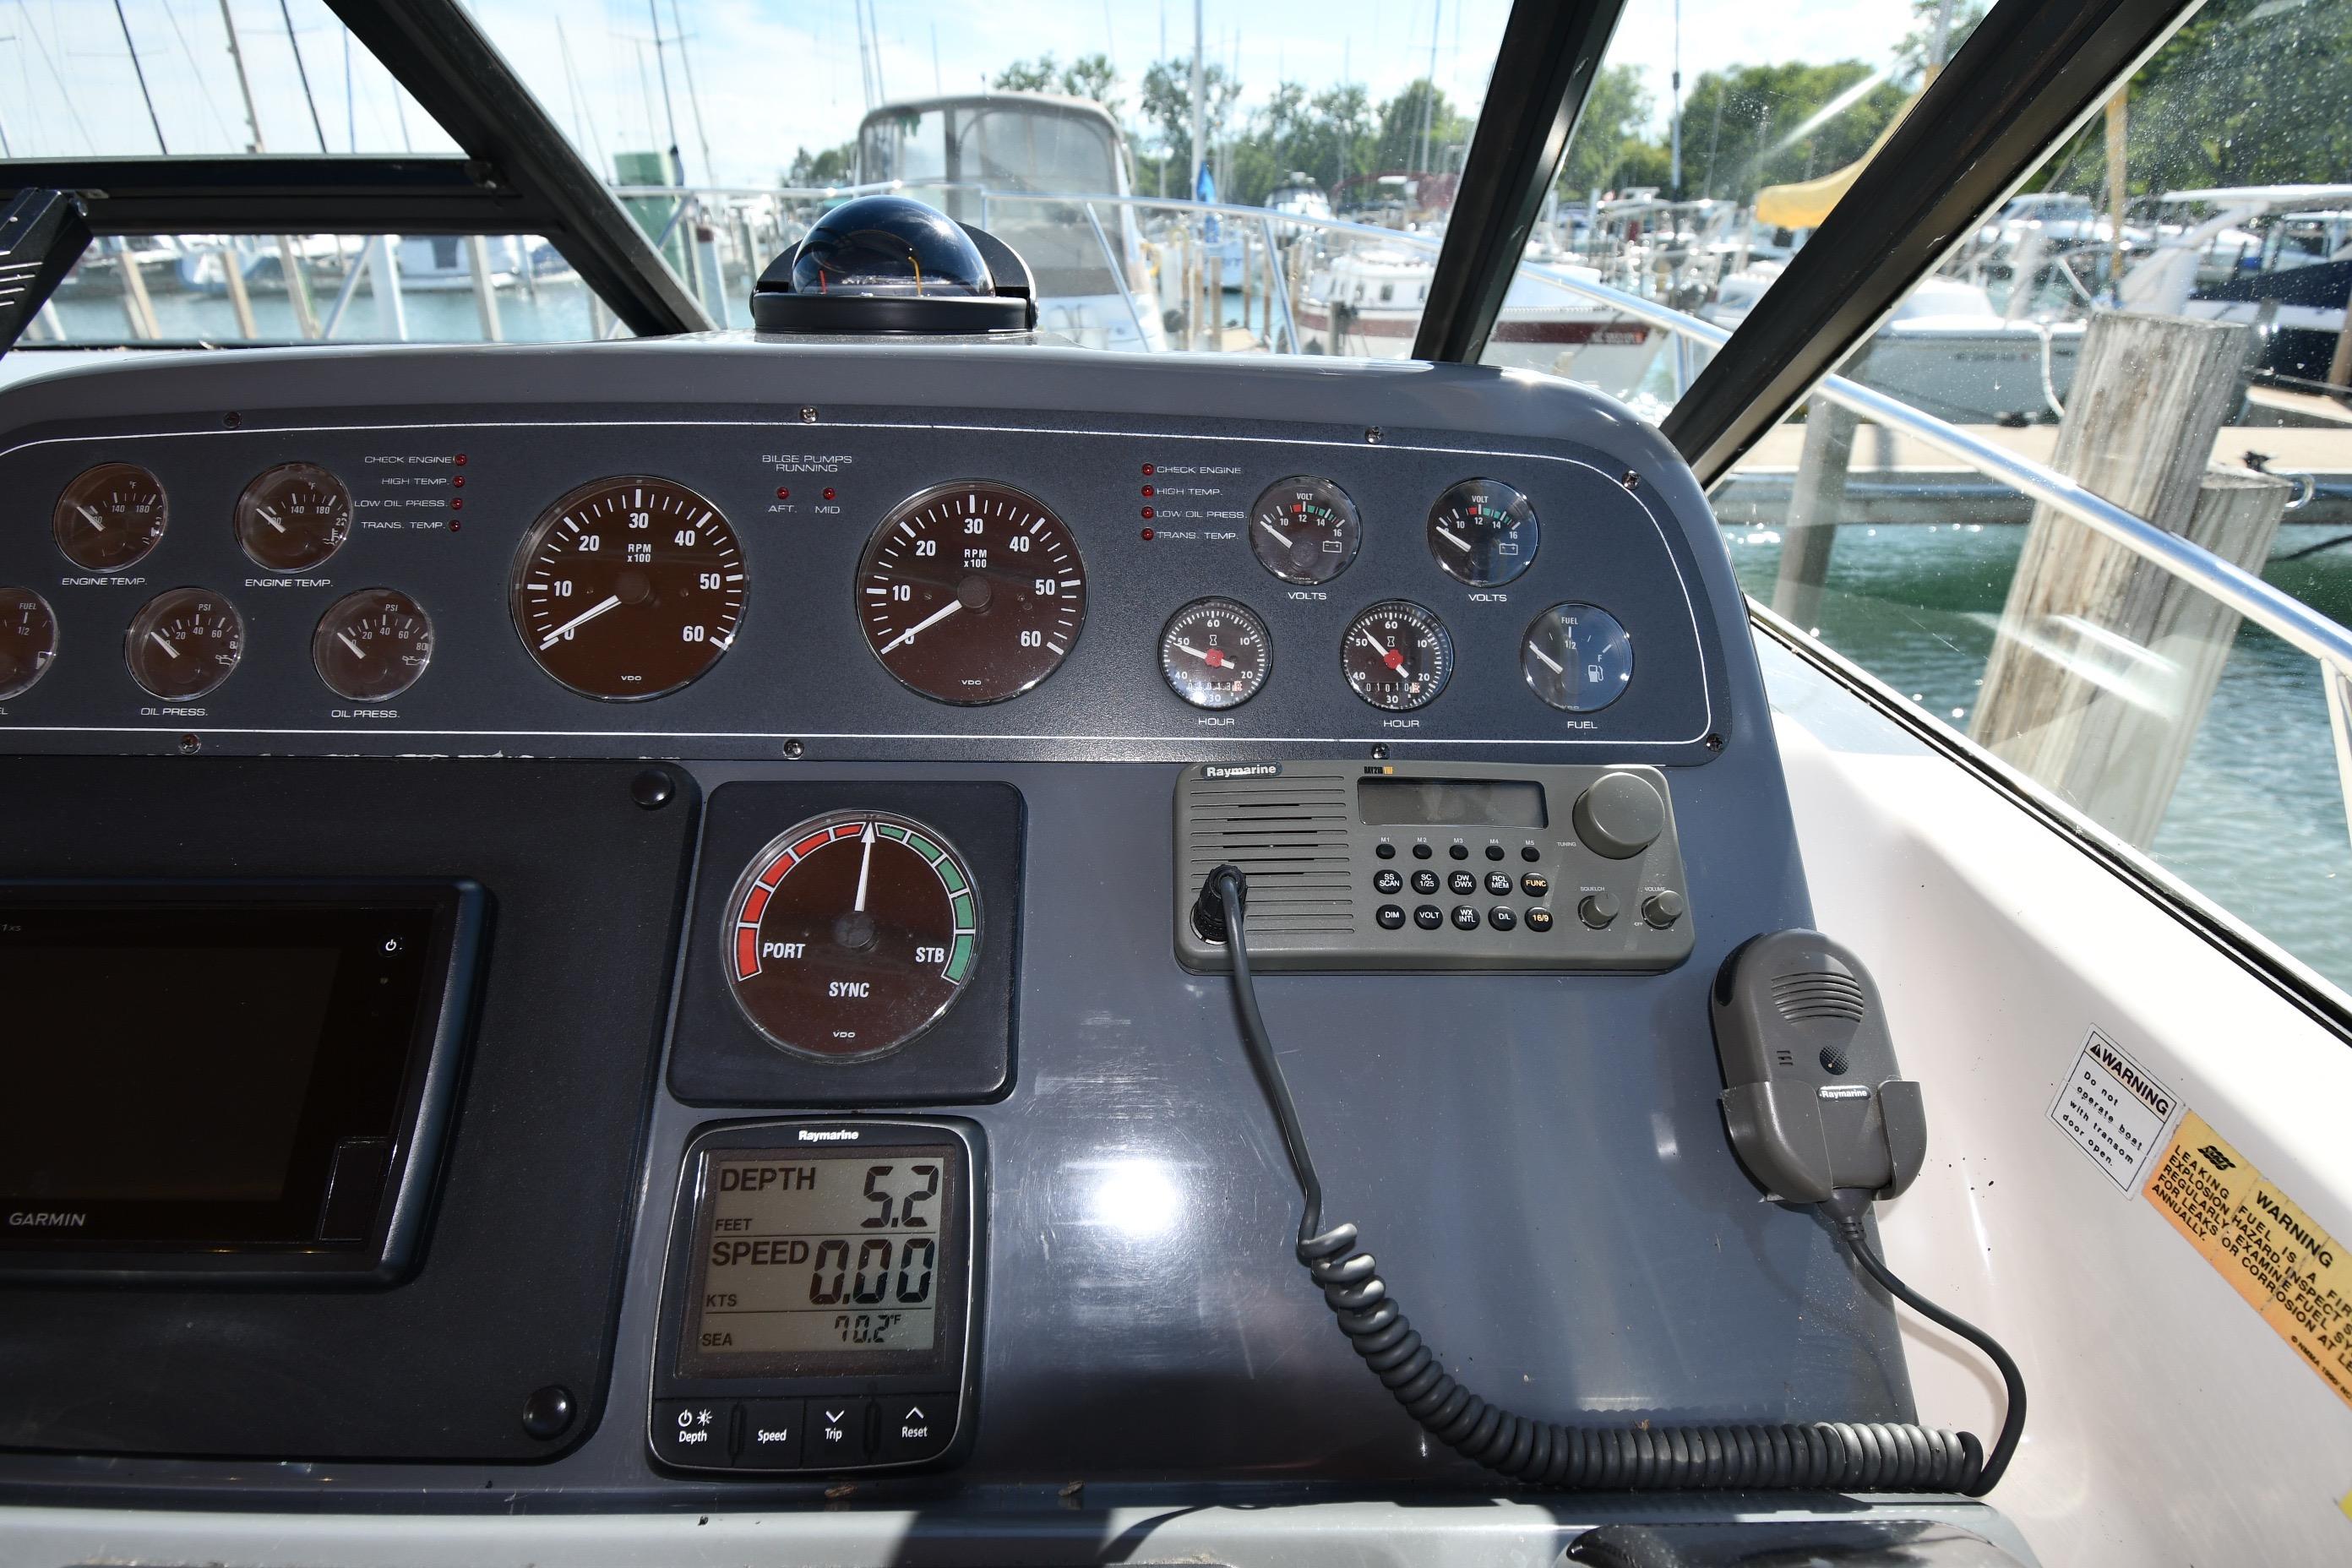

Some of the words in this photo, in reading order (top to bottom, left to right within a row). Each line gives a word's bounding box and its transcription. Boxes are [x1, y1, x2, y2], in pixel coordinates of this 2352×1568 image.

[629, 513, 648, 529] 30
[964, 519, 983, 534] 30
[579, 536, 599, 551] 20
[675, 531, 694, 547] 40
[1010, 536, 1029, 552] 40
[629, 544, 651, 553] RPM
[916, 541, 935, 556] 20
[964, 549, 987, 558] RPM
[554, 580, 572, 596] 10
[700, 574, 720, 590] 50
[1036, 580, 1055, 596] 50
[893, 585, 911, 601] 10
[683, 626, 704, 641] 60
[1021, 631, 1041, 647] 60
[162, 708, 209, 716] PRESS.
[1206, 765, 1277, 777] Raymarine
[762, 943, 806, 959] PORT
[915, 948, 945, 963] STB
[829, 982, 869, 998] SYNC
[2084, 1071, 2097, 1086] Do
[2101, 1088, 2119, 1107] not
[2103, 1048, 2169, 1115] WARNING
[1821, 1090, 1867, 1098] Raymarine
[2077, 1086, 2114, 1123] operate
[2119, 1124, 2142, 1151] boat
[798, 1130, 858, 1141] Raymarine
[2062, 1113, 2084, 1136] door
[2088, 1139, 2113, 1166] open.
[2070, 1100, 2089, 1121] with
[2093, 1122, 2133, 1164] transom
[720, 1168, 815, 1192] DEPTH
[860, 1165, 939, 1228] 5.2
[8, 1213, 86, 1227] GARMIN
[2152, 1184, 2207, 1241] ANNUALLY.
[2175, 1145, 2230, 1200] LEAKING
[2239, 1205, 2271, 1242] FUEL
[2282, 1246, 2297, 1264] IS
[2306, 1272, 2317, 1284] A
[715, 1218, 752, 1231] FEET
[2256, 1190, 2333, 1269] WARNING
[2170, 1155, 2230, 1215] EXPLOSION
[2285, 1266, 2343, 1323] INSPECT
[2164, 1164, 2230, 1234] REGULARLY.
[2235, 1234, 2292, 1293] EXAMINE
[2295, 1294, 2329, 1331] FUEL
[2158, 1173, 2180, 1198] FOR
[2182, 1197, 2219, 1236] LEAKS
[2222, 1238, 2239, 1257] OR
[2241, 1256, 2317, 1333] CORROSION
[2317, 1334, 2337, 1352] AT
[711, 1241, 809, 1266] SPEED
[808, 1239, 935, 1304] 0.00
[706, 1294, 737, 1307] KTS
[702, 1333, 732, 1347] SEA
[679, 1430, 707, 1443] Depth
[758, 1430, 787, 1442] Speed
[825, 1428, 842, 1440] Trip
[901, 1426, 928, 1437] Reset
